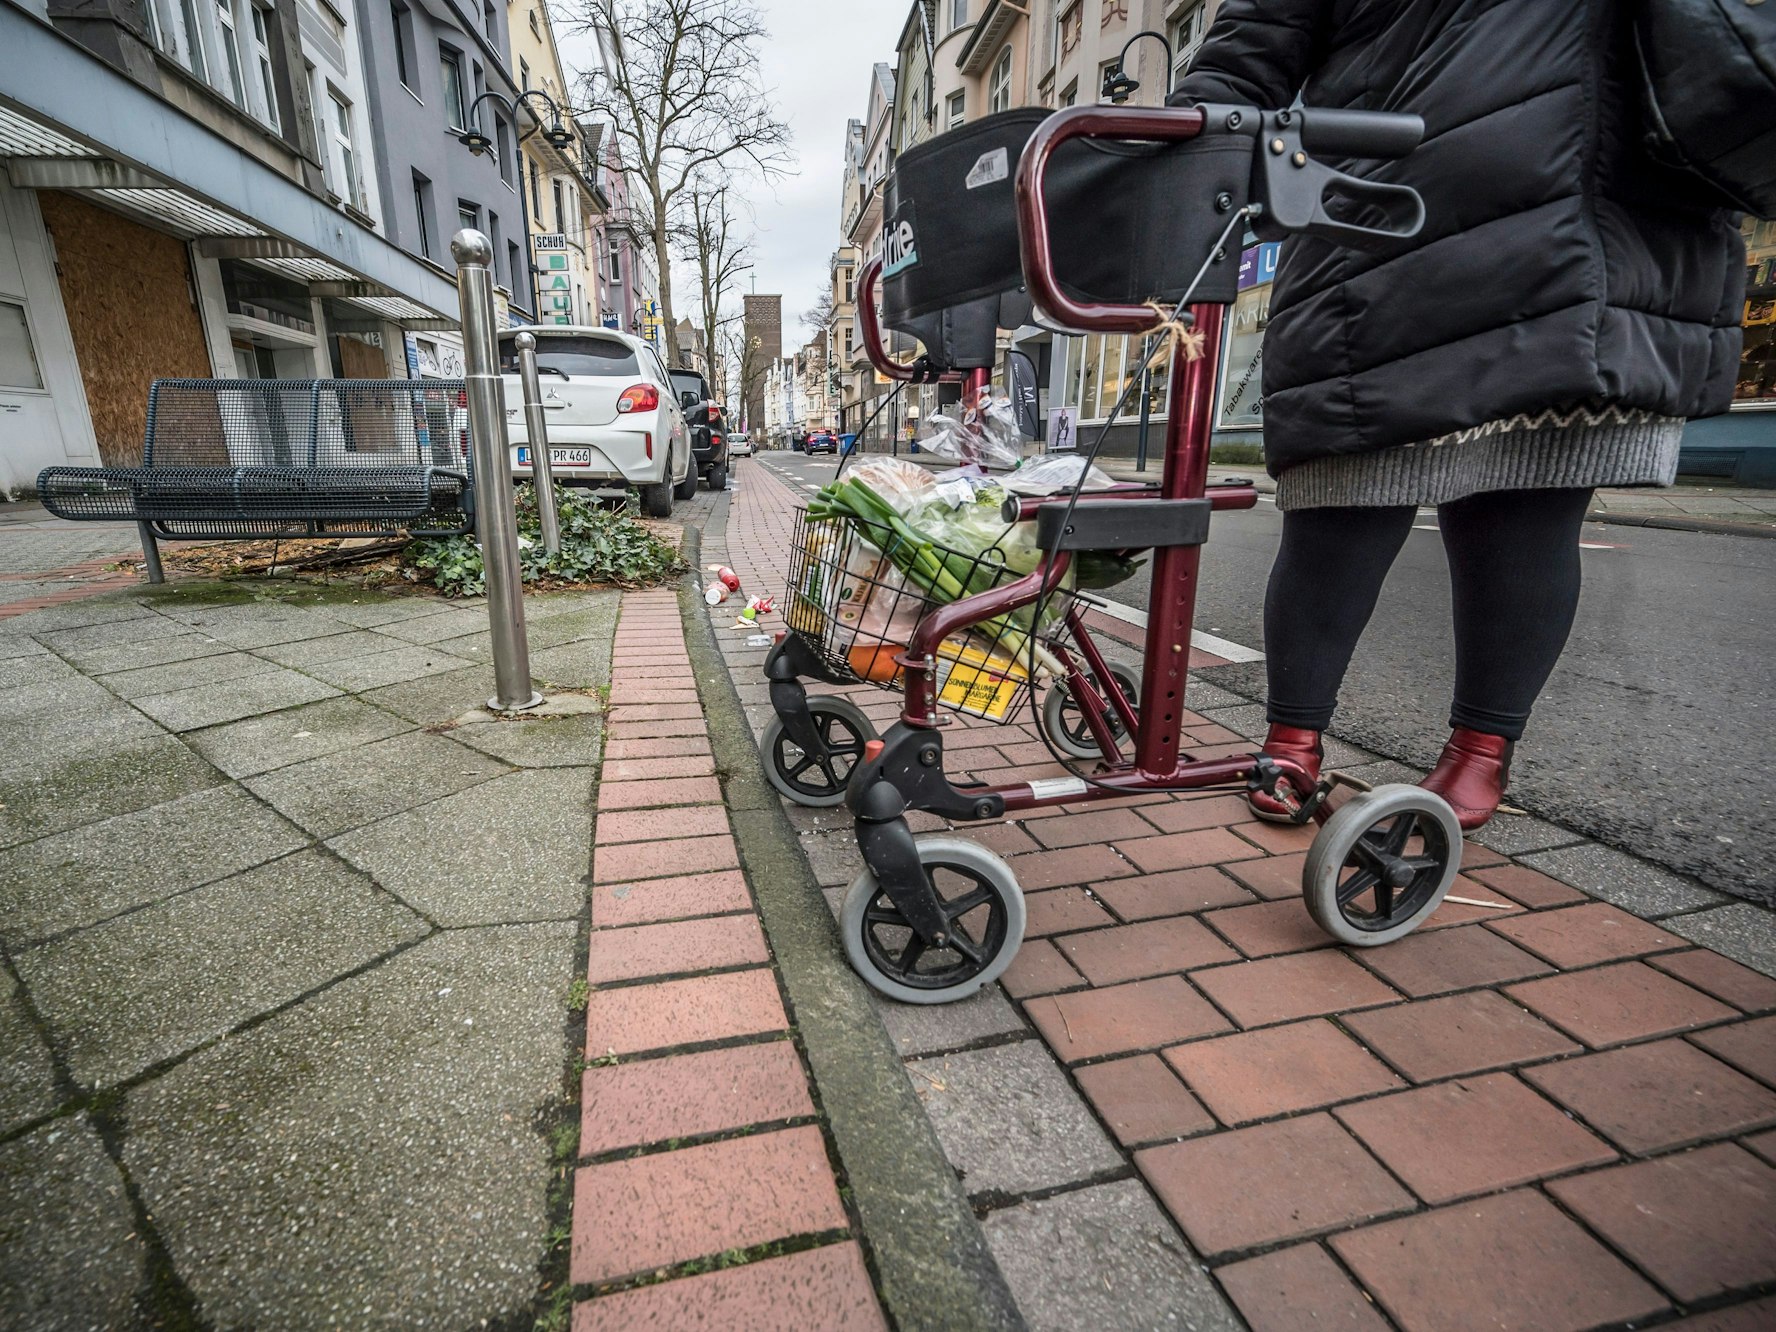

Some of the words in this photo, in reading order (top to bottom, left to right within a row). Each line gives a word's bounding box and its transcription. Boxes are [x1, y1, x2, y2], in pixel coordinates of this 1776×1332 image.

[537, 235, 564, 248] SCHUH
[553, 450, 567, 461] PR
[569, 450, 588, 461] 466
